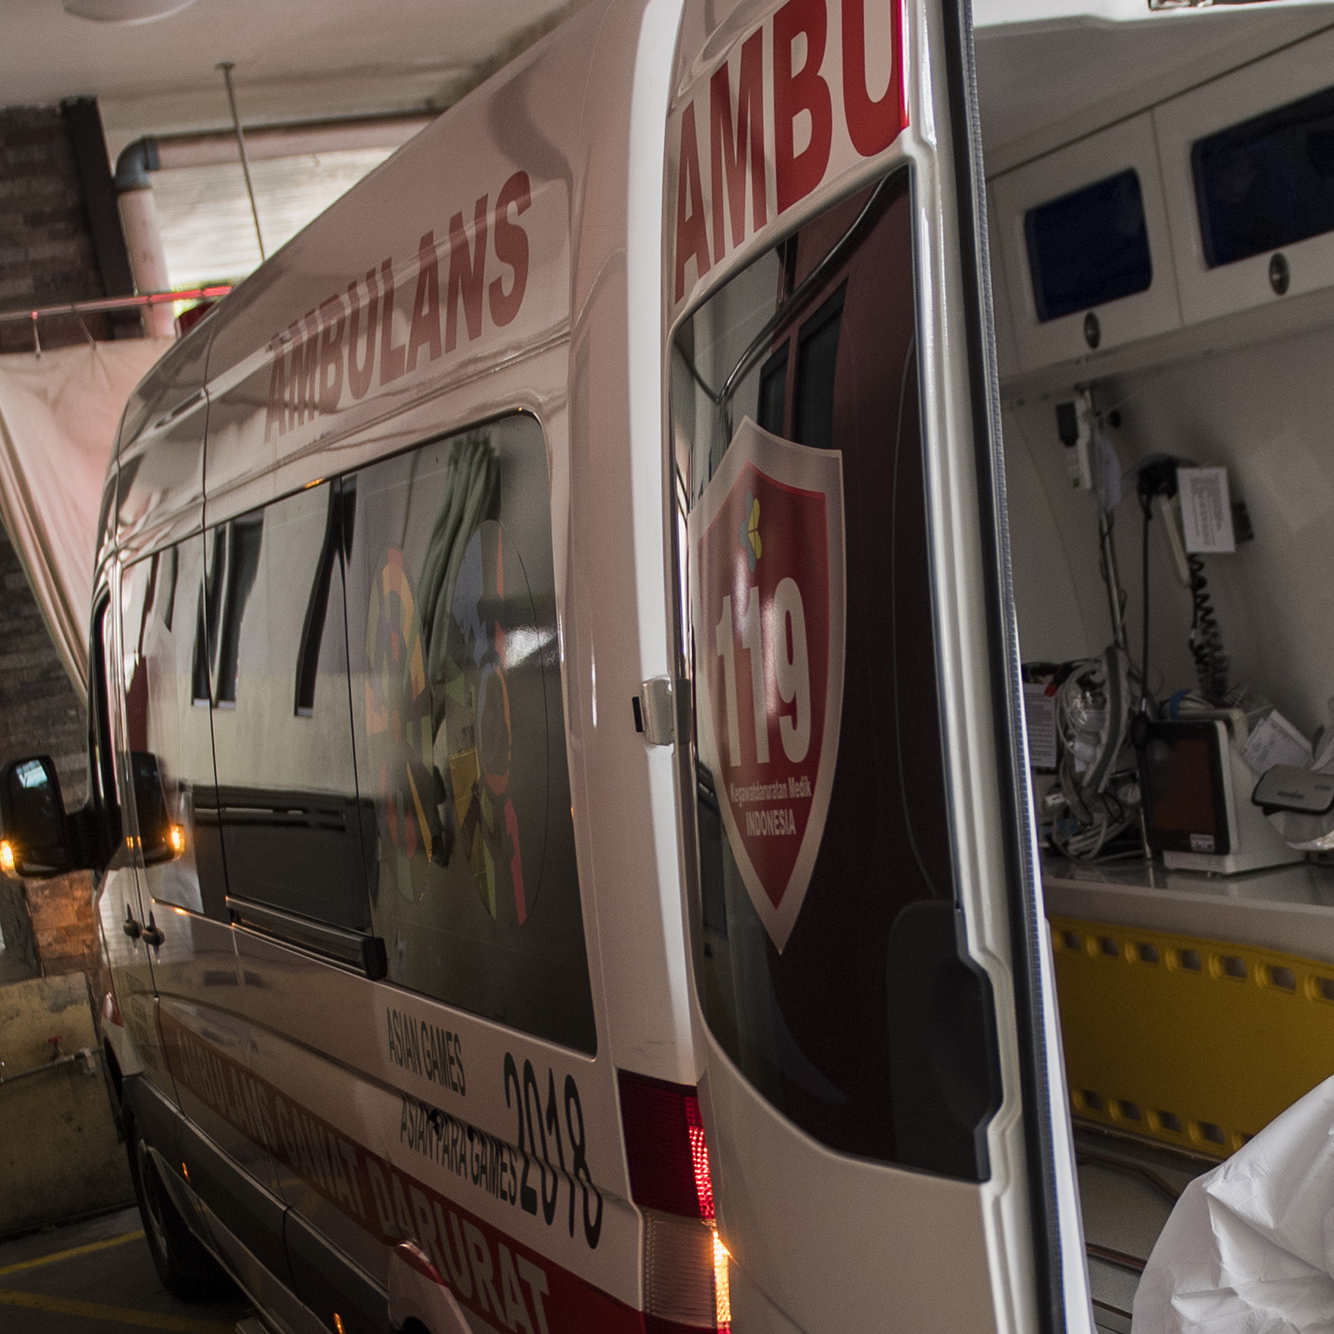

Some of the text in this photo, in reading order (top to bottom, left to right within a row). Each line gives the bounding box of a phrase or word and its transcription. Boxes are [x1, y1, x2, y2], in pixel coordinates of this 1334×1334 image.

[263, 170, 532, 445] AMBULANS
[716, 577, 811, 767] 119
[745, 808, 797, 837] INDONESIA
[176, 1027, 279, 1150] AMBULANS
[276, 1095, 366, 1220] GAWAT
[386, 1006, 466, 1096] ASIAN GAMES
[399, 1091, 519, 1206] ASIAN PARA GAMES
[503, 1051, 604, 1250] 2018
